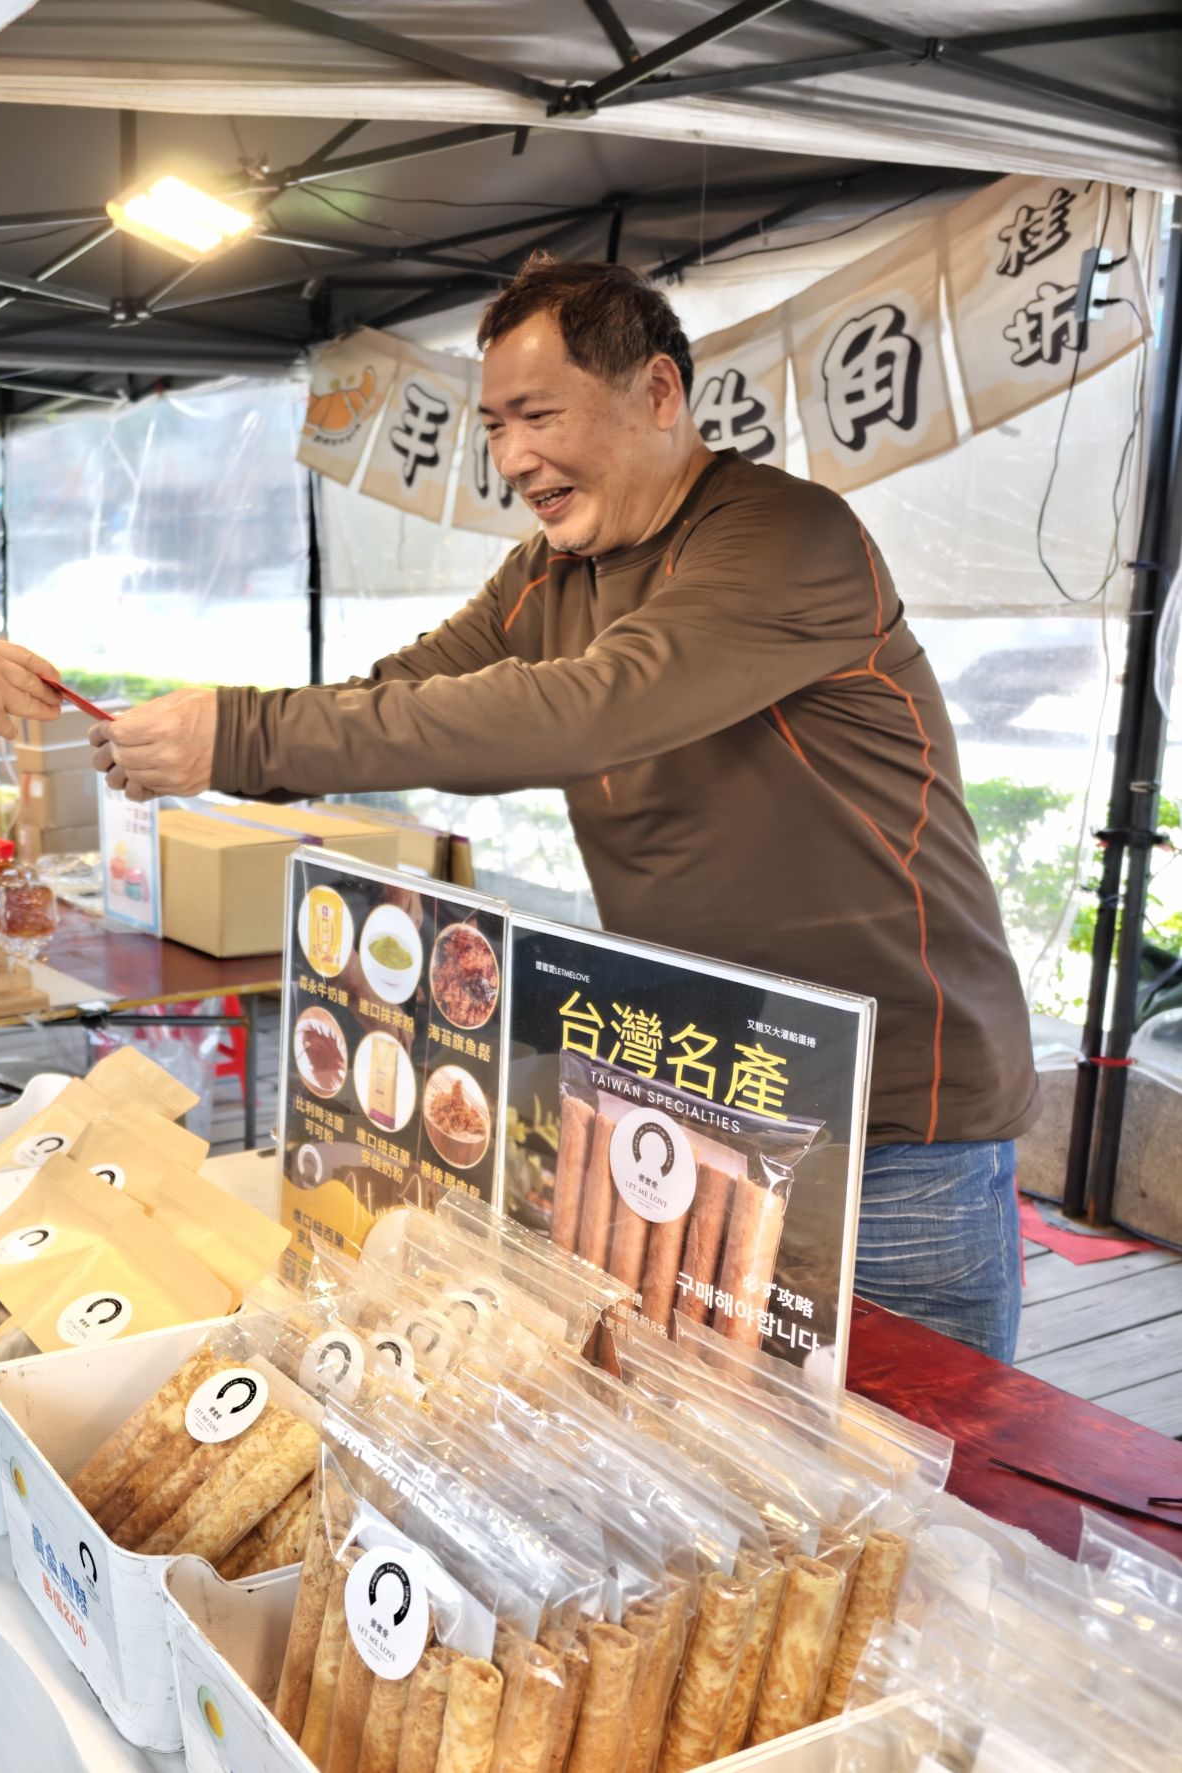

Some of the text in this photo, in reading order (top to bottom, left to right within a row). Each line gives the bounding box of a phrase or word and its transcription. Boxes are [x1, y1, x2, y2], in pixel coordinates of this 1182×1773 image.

[358, 997, 415, 1034] 進口抹茶粉
[558, 990, 790, 1122] 台灣名產
[304, 1118, 334, 1145] 可可粉
[590, 1070, 741, 1134] TAIWAN SPECIALTIES
[675, 1270, 821, 1357] 구매해야합니다
